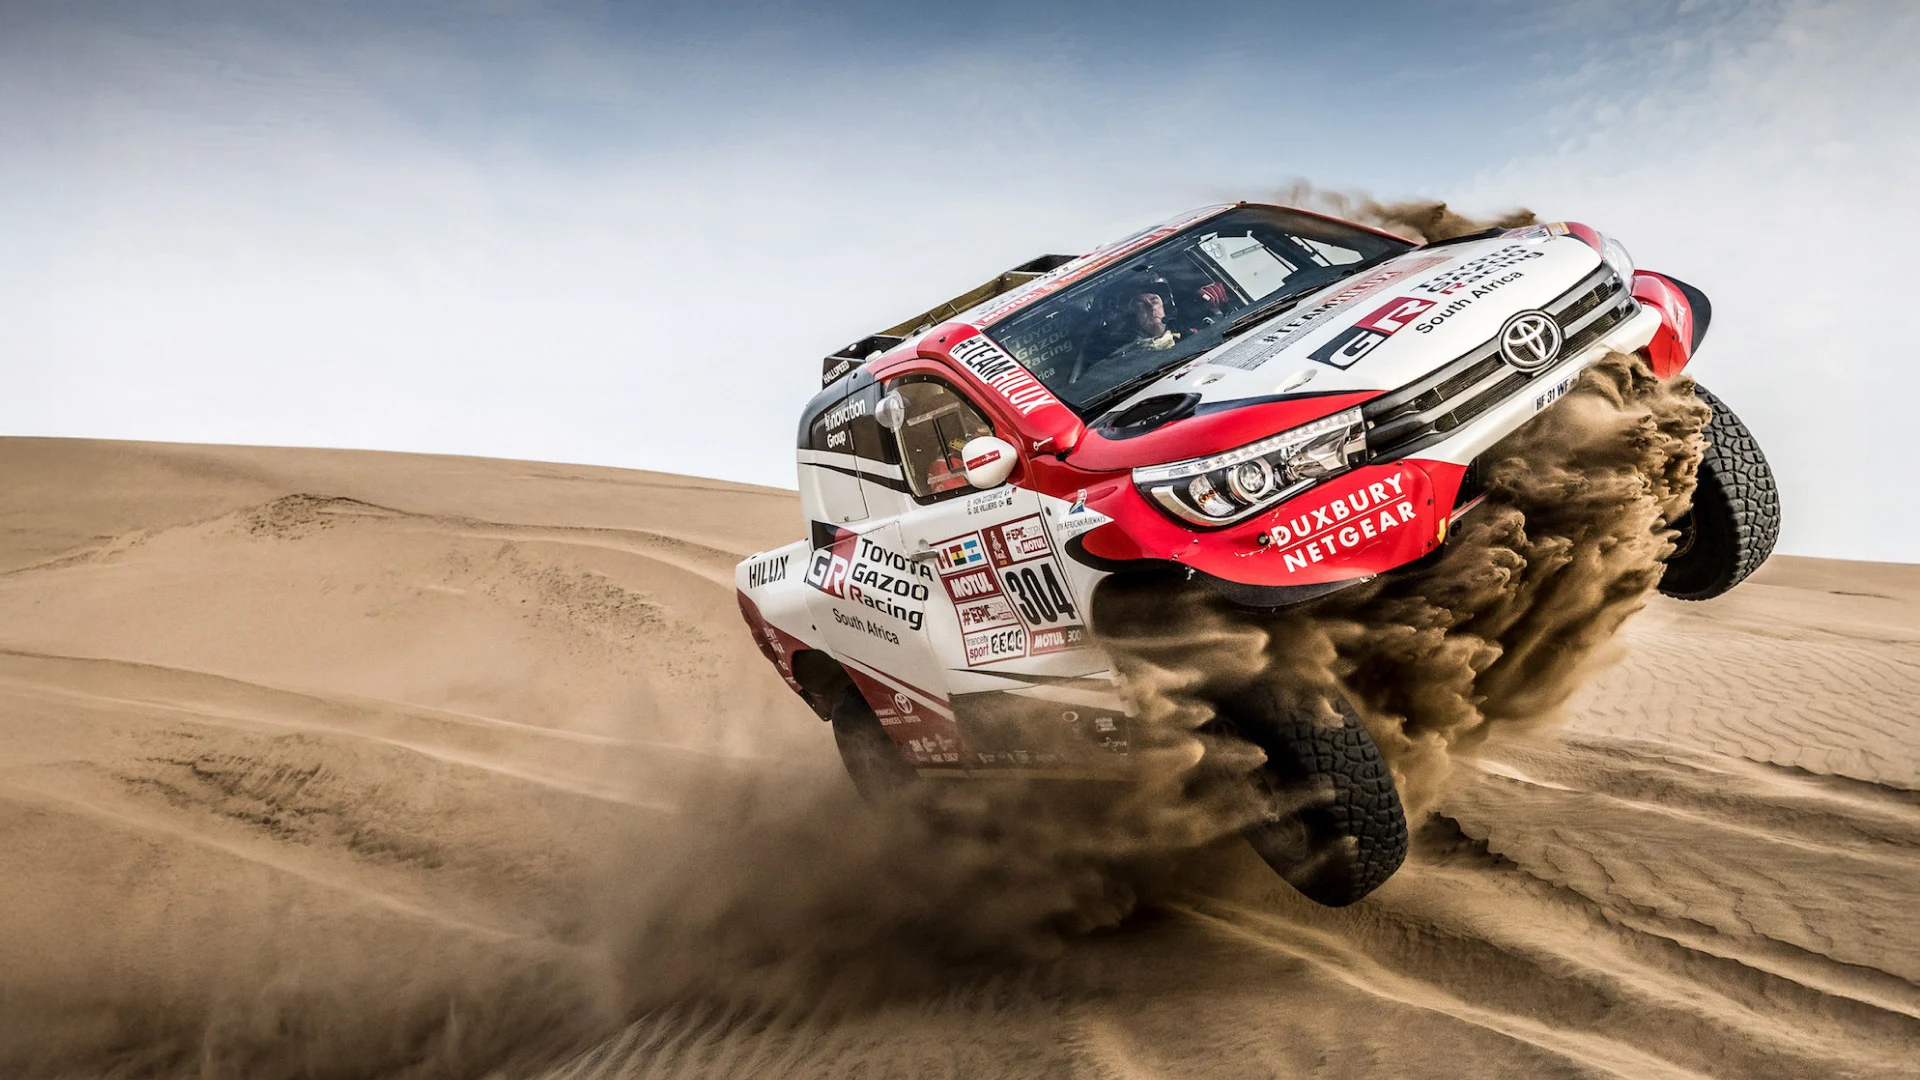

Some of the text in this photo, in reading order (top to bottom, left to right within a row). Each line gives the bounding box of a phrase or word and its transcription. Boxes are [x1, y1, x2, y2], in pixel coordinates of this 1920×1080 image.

[1410, 245, 1522, 291] TOYOTA
[1427, 249, 1527, 292] GAZOO
[1440, 252, 1544, 294] Racing
[1416, 271, 1524, 334] South Africa
[1328, 297, 1434, 367] GR
[951, 335, 1056, 416] #TEAMHILUX
[827, 430, 847, 449] Group
[1271, 472, 1402, 547] DUXBURY
[1022, 537, 1046, 552] MOTUL
[1282, 501, 1417, 573] NETGEAR
[807, 549, 849, 599] GR
[851, 562, 929, 602] GAZOO
[862, 538, 934, 582] TOYOTA
[950, 571, 994, 599] MOTUL
[1005, 563, 1076, 625] 304
[832, 608, 900, 645] South Africa
[850, 584, 924, 631] Racing
[969, 644, 989, 661] sport
[1034, 631, 1065, 648] MOTUL
